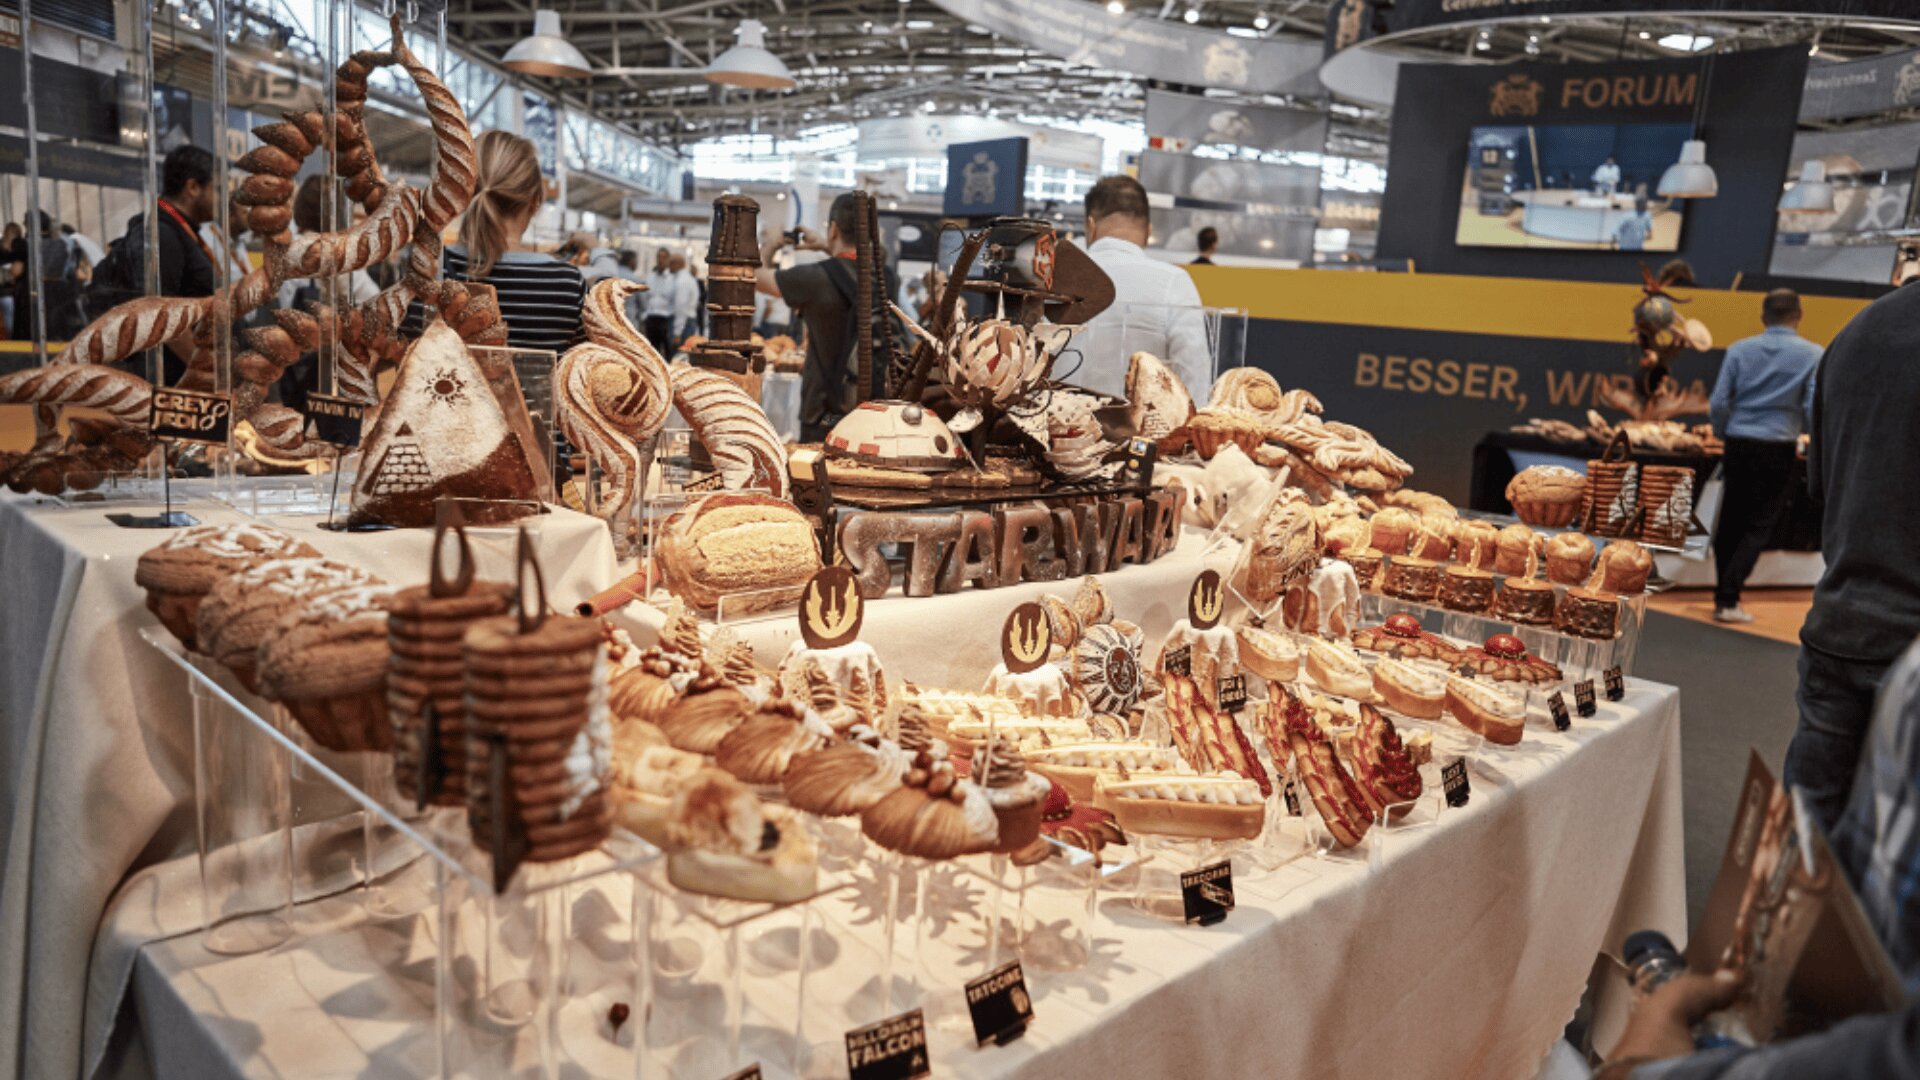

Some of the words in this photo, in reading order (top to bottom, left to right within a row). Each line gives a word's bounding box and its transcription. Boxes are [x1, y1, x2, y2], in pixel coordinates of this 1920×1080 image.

[1561, 73, 1697, 109] FORUM
[1355, 353, 1528, 412] BESSER,
[153, 394, 214, 414] GREY
[307, 400, 345, 416] YAVIN
[151, 410, 199, 430] JEDI
[850, 1030, 924, 1069] FALCON
